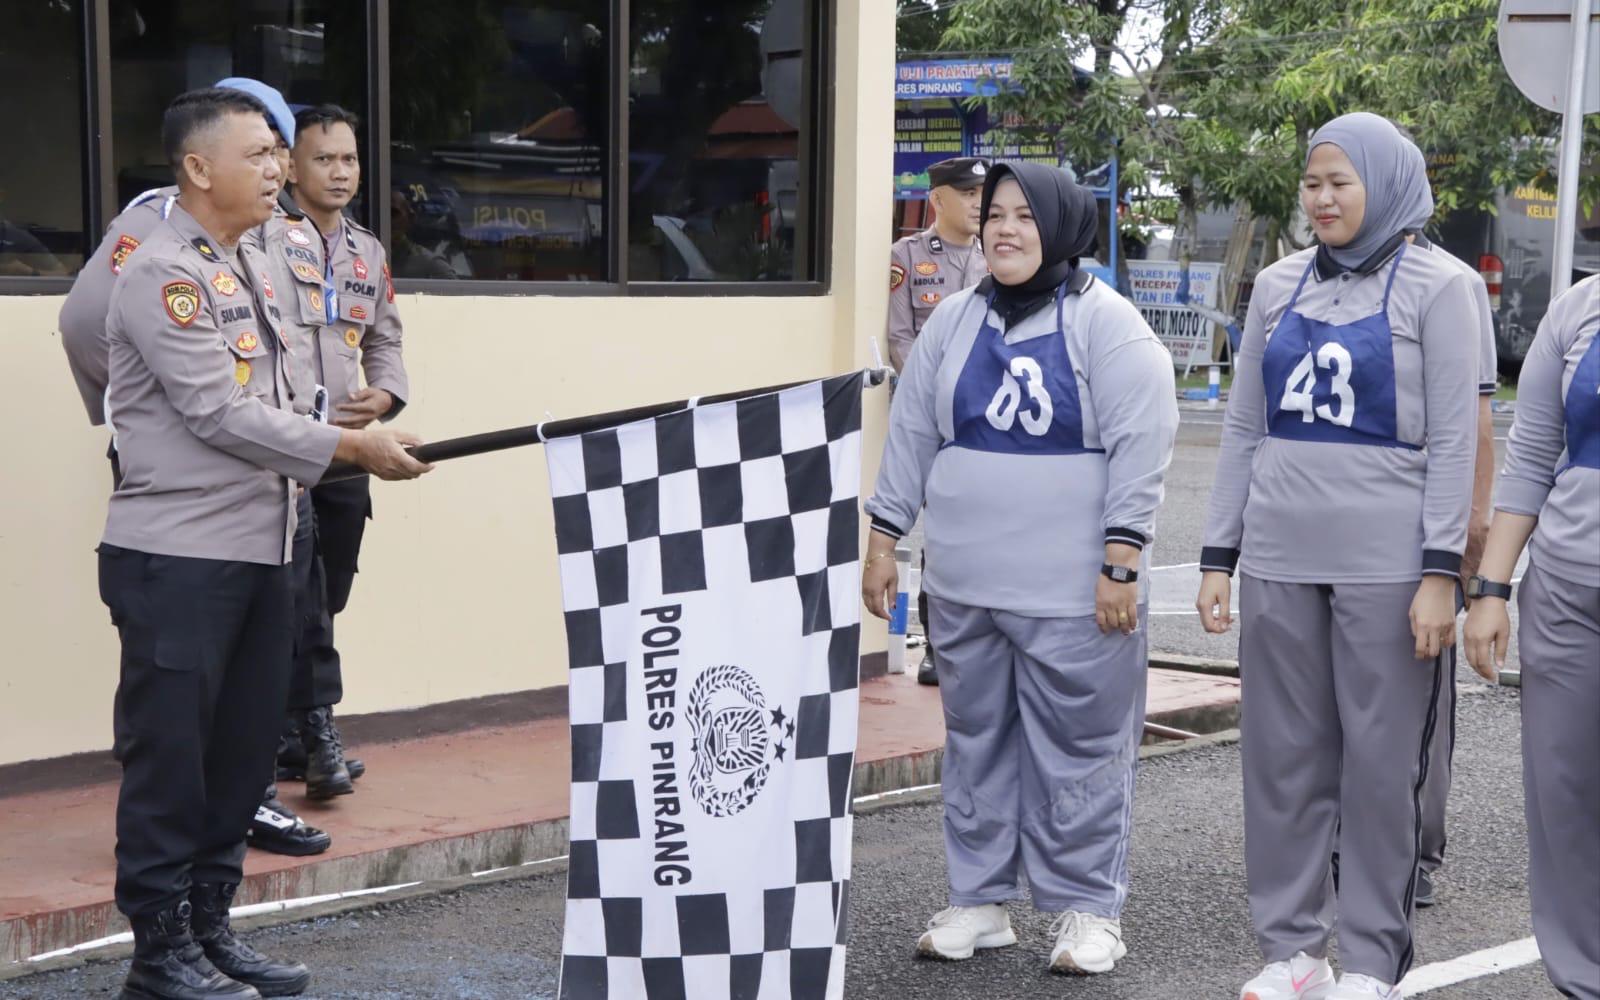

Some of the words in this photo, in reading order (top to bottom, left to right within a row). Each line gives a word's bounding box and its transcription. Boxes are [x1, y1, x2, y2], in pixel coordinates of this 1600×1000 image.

[895, 83, 917, 94] RES
[919, 82, 962, 93] PINRANG
[901, 66, 923, 80] UJI
[927, 64, 992, 79] PRAKTEK
[344, 281, 376, 297] POLRI
[1280, 341, 1355, 428] 43
[640, 603, 682, 731] POLRES
[650, 741, 692, 886] PINRANG
